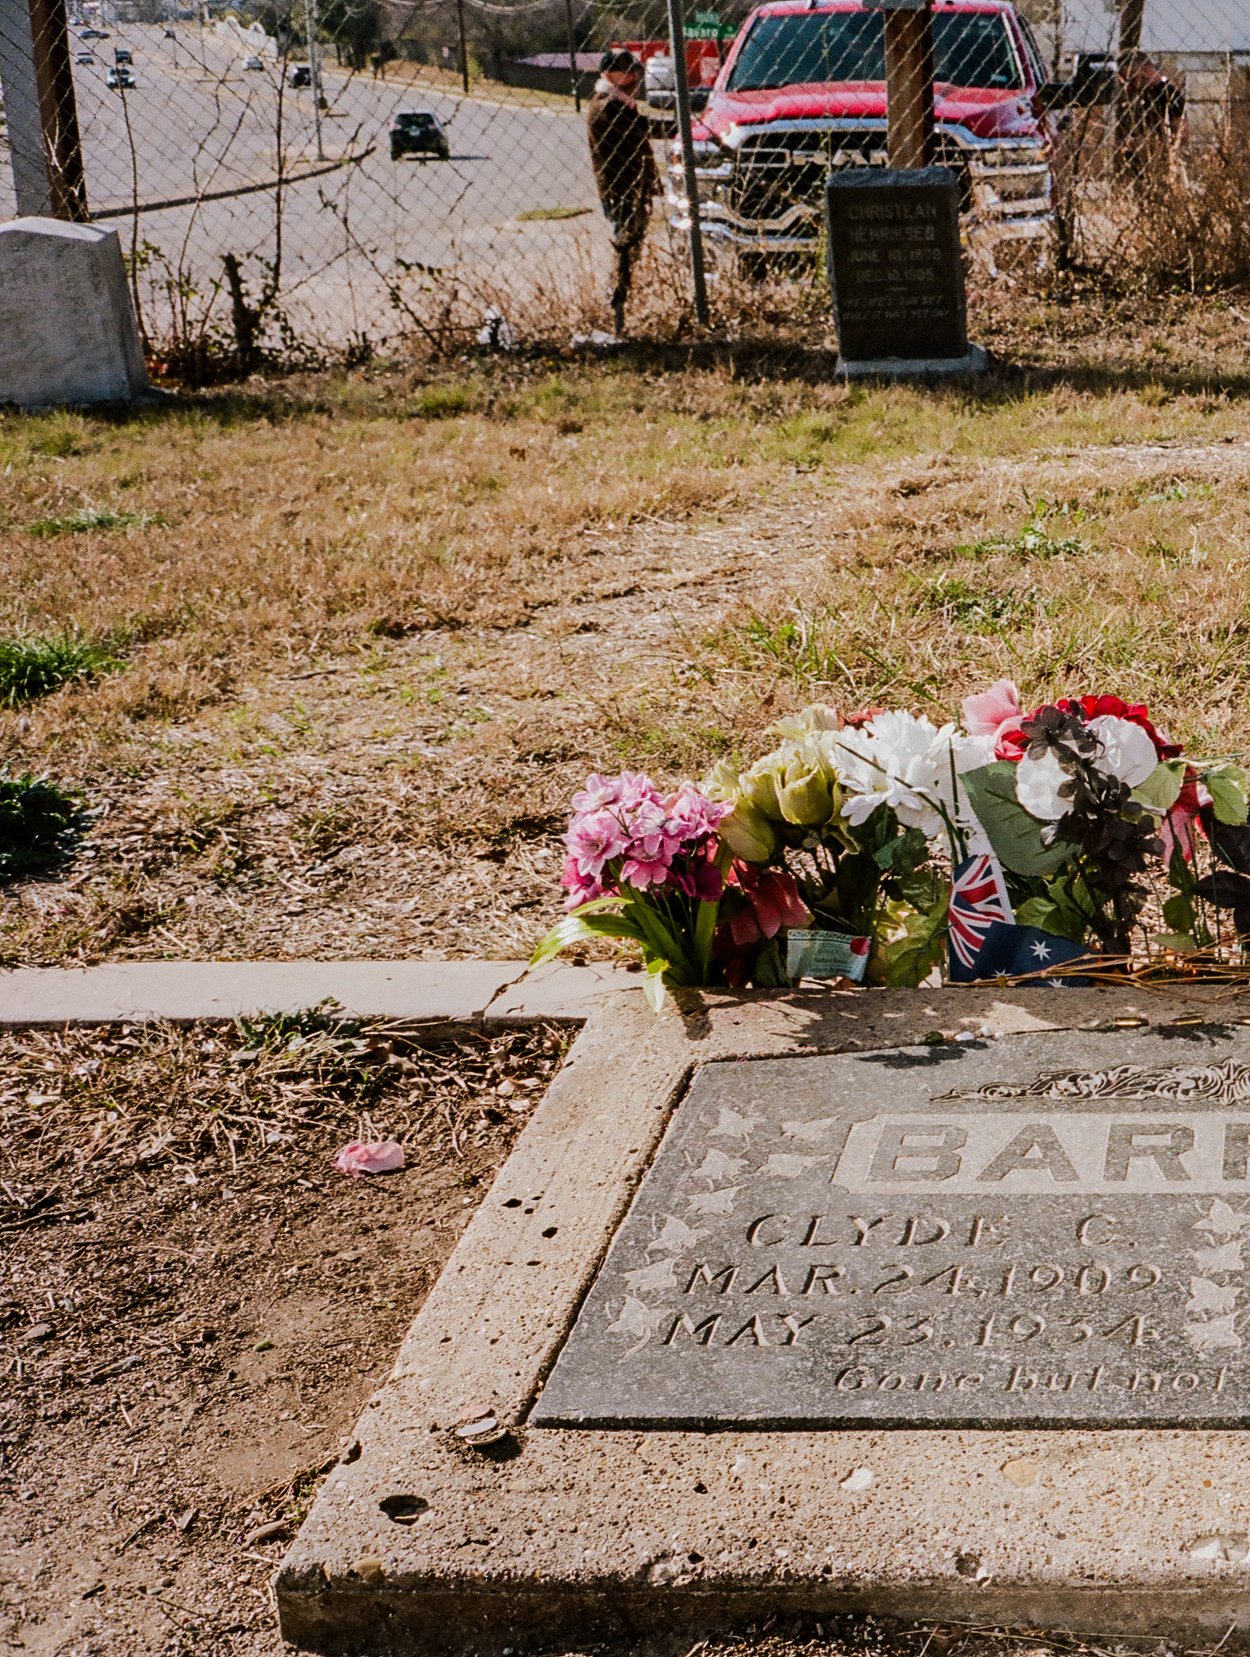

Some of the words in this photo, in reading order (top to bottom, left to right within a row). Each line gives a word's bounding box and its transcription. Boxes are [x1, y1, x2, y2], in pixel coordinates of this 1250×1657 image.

[683, 27, 719, 39] avaro
[847, 249, 881, 263] JUNE
[745, 1213, 1011, 1248] CLYDE
[1075, 1213, 1139, 1249] C.
[998, 1262, 1162, 1297] 1909
[660, 1312, 820, 1347] MAY
[973, 1311, 1162, 1347] 1934
[834, 1365, 986, 1392] Gone
[1003, 1364, 1105, 1393] but
[1125, 1364, 1229, 1393] not
